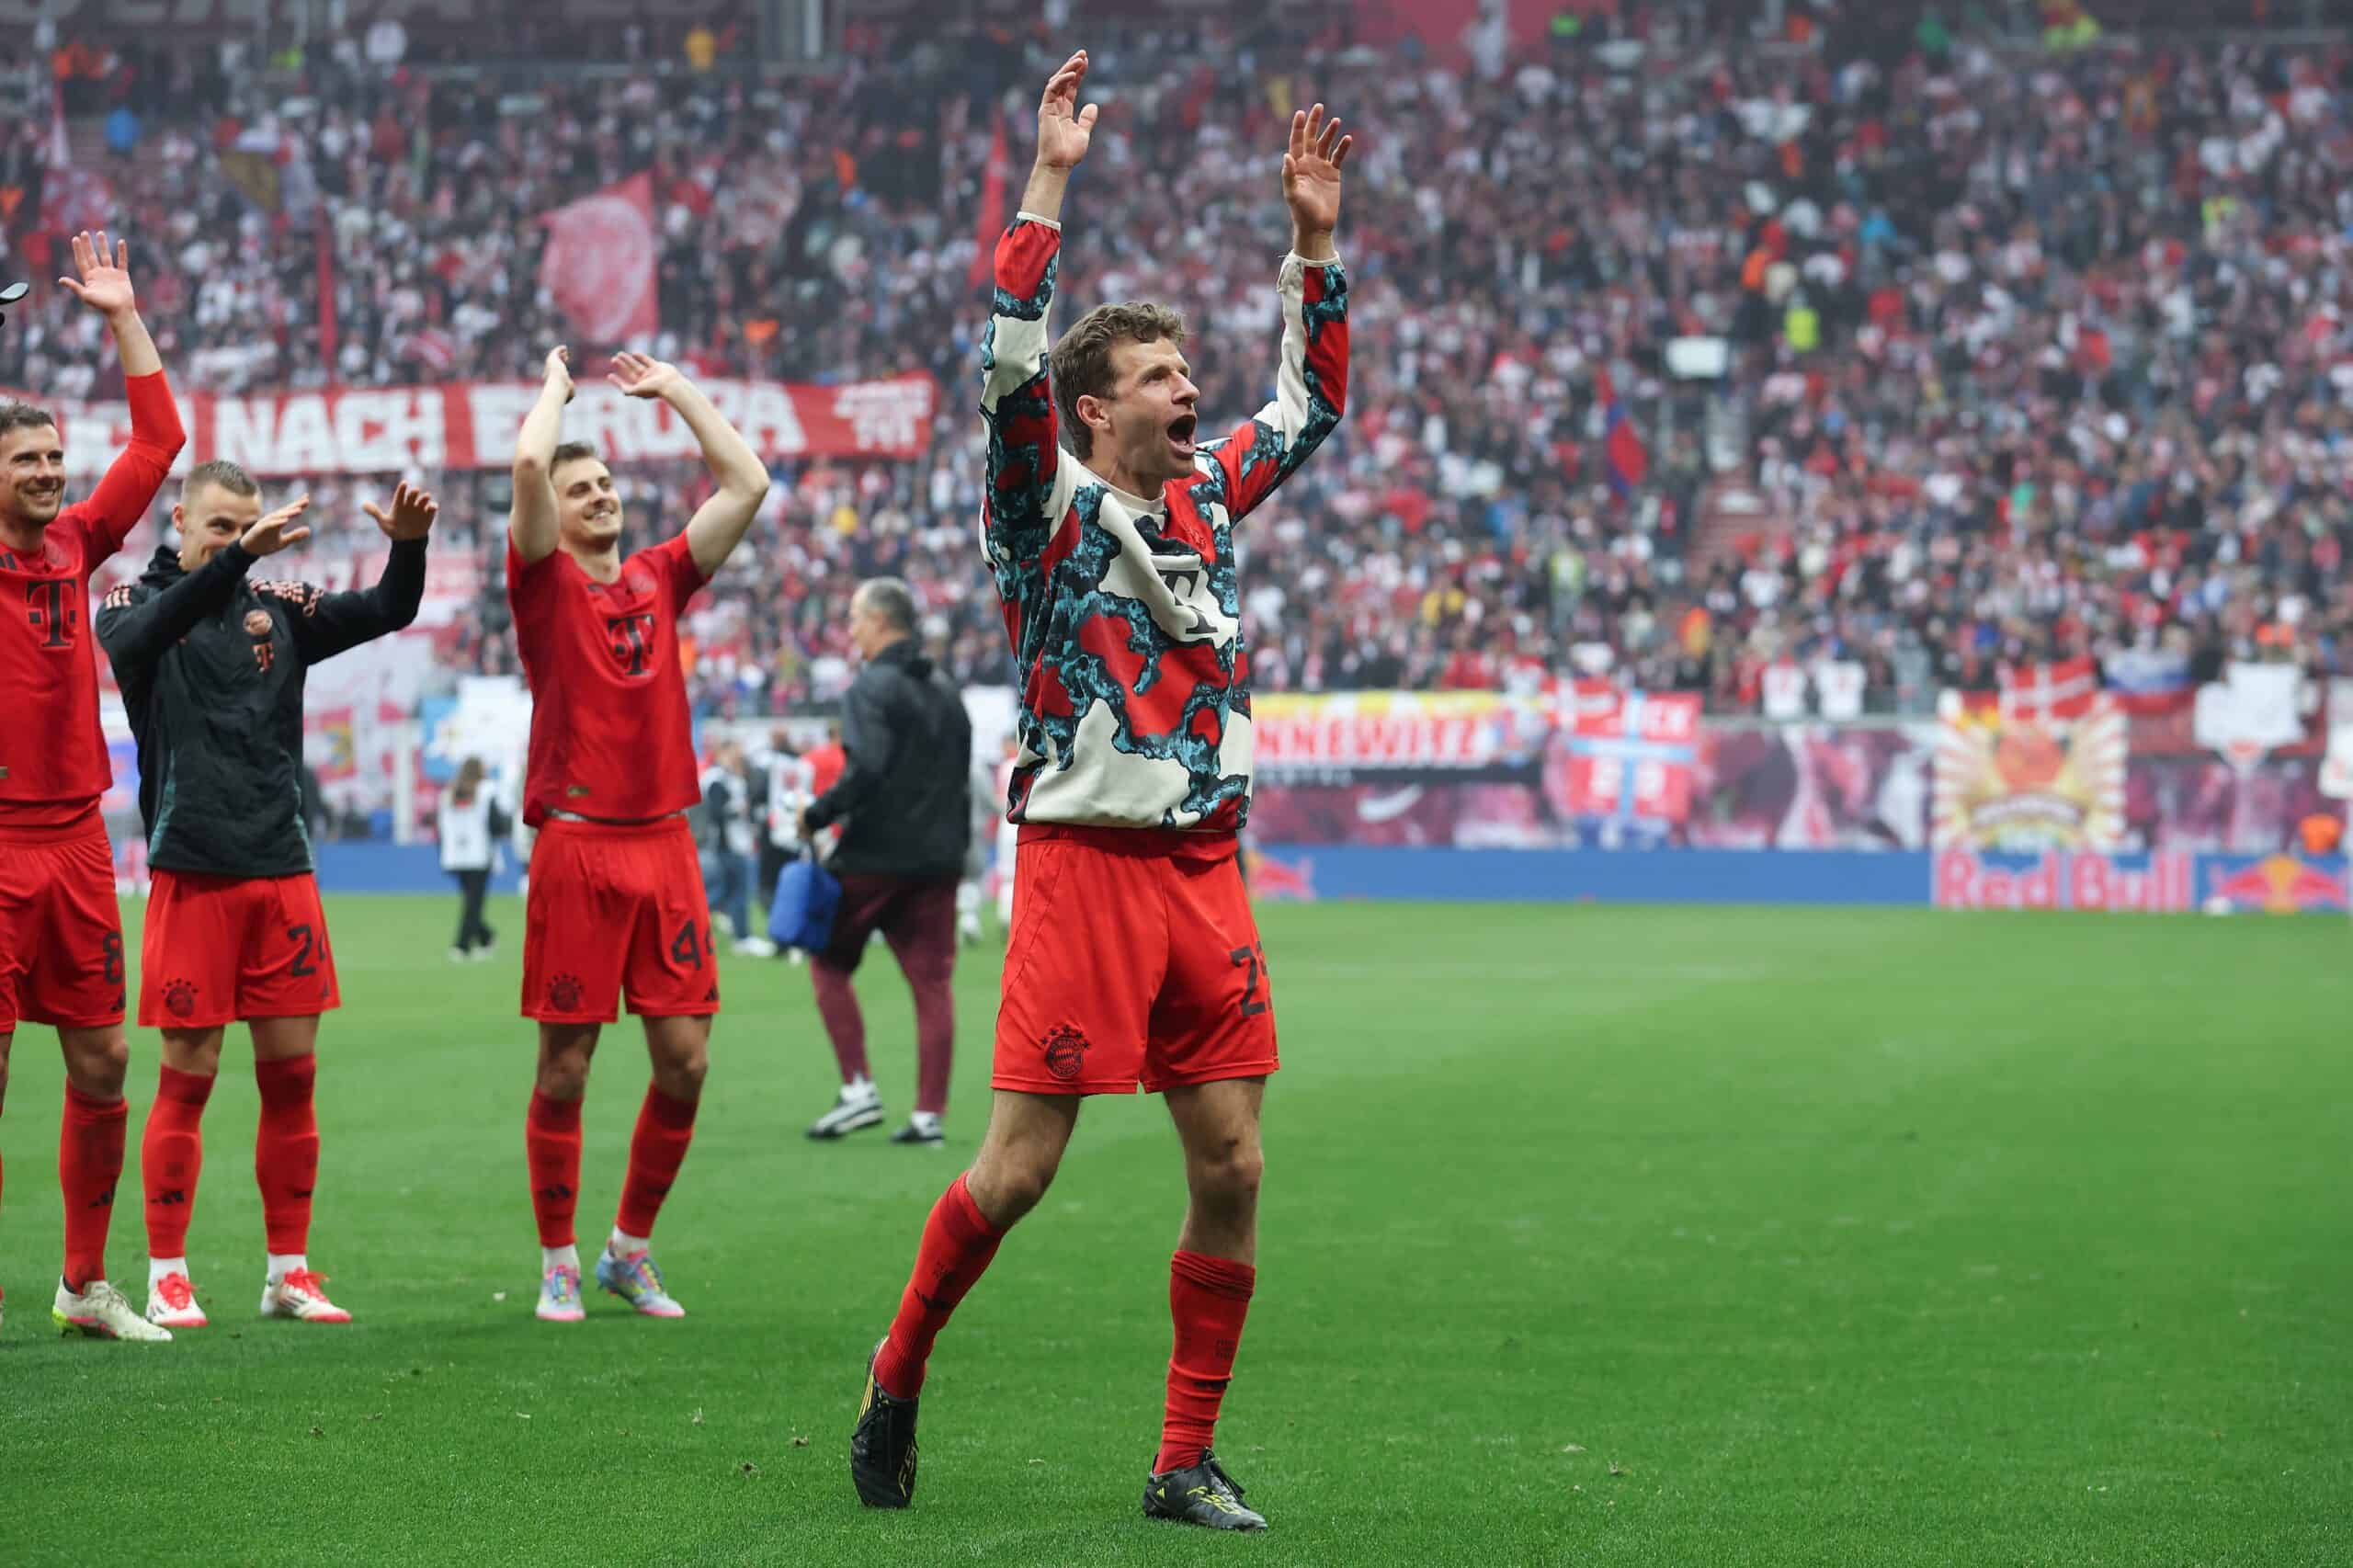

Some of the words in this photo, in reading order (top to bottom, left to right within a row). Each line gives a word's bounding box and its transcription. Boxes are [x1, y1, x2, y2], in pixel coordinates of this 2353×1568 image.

[215, 388, 447, 473] NACH
[1938, 851, 2058, 910] Red
[2072, 851, 2191, 910] Bull
